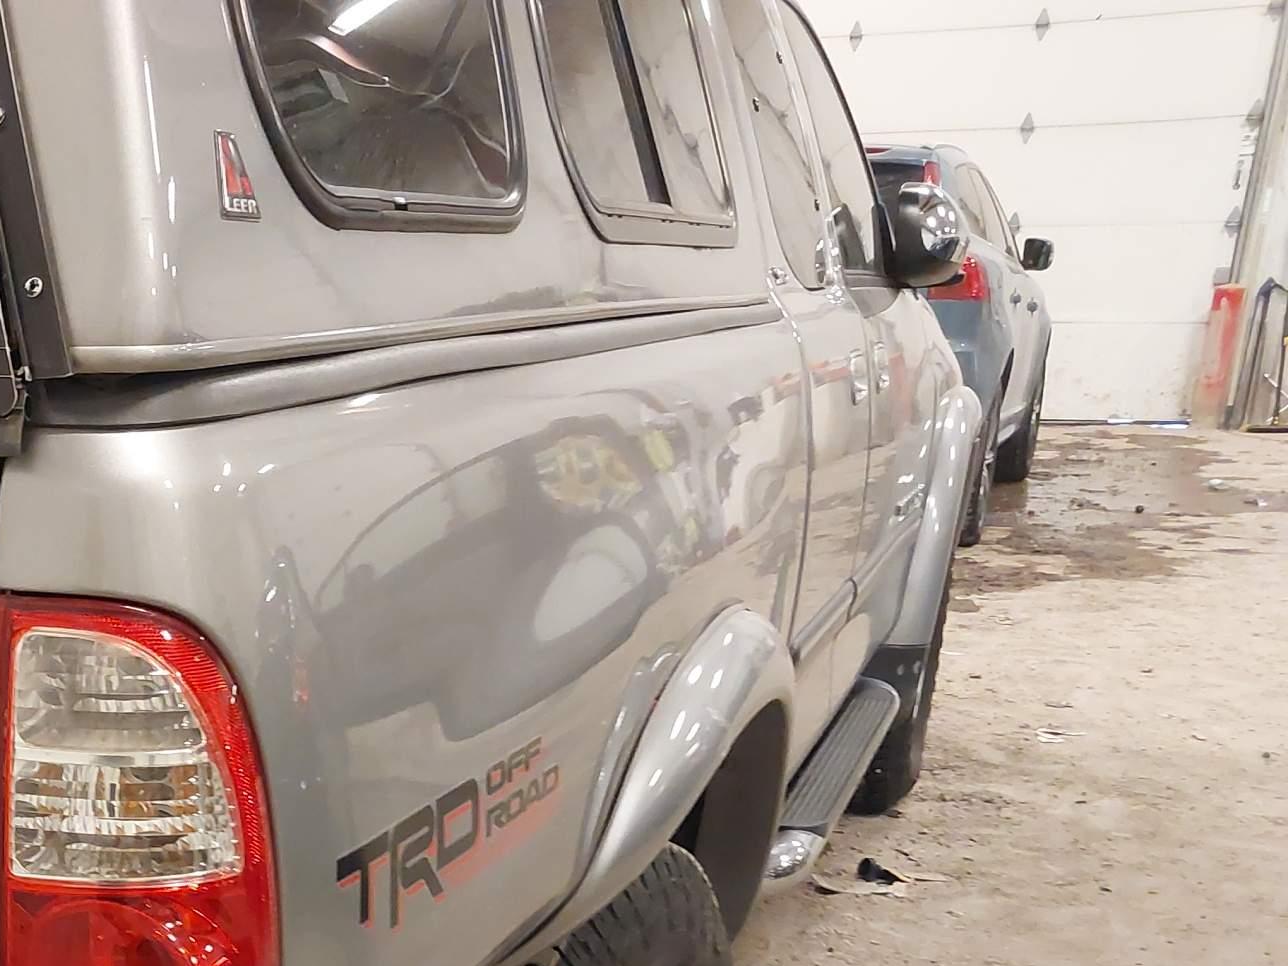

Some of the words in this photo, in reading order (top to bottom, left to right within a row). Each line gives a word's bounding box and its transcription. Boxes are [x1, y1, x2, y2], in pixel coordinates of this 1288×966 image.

[224, 196, 257, 213] LEER
[486, 737, 542, 795] OFF
[486, 764, 559, 838] ROAD
[336, 778, 479, 929] TRD
